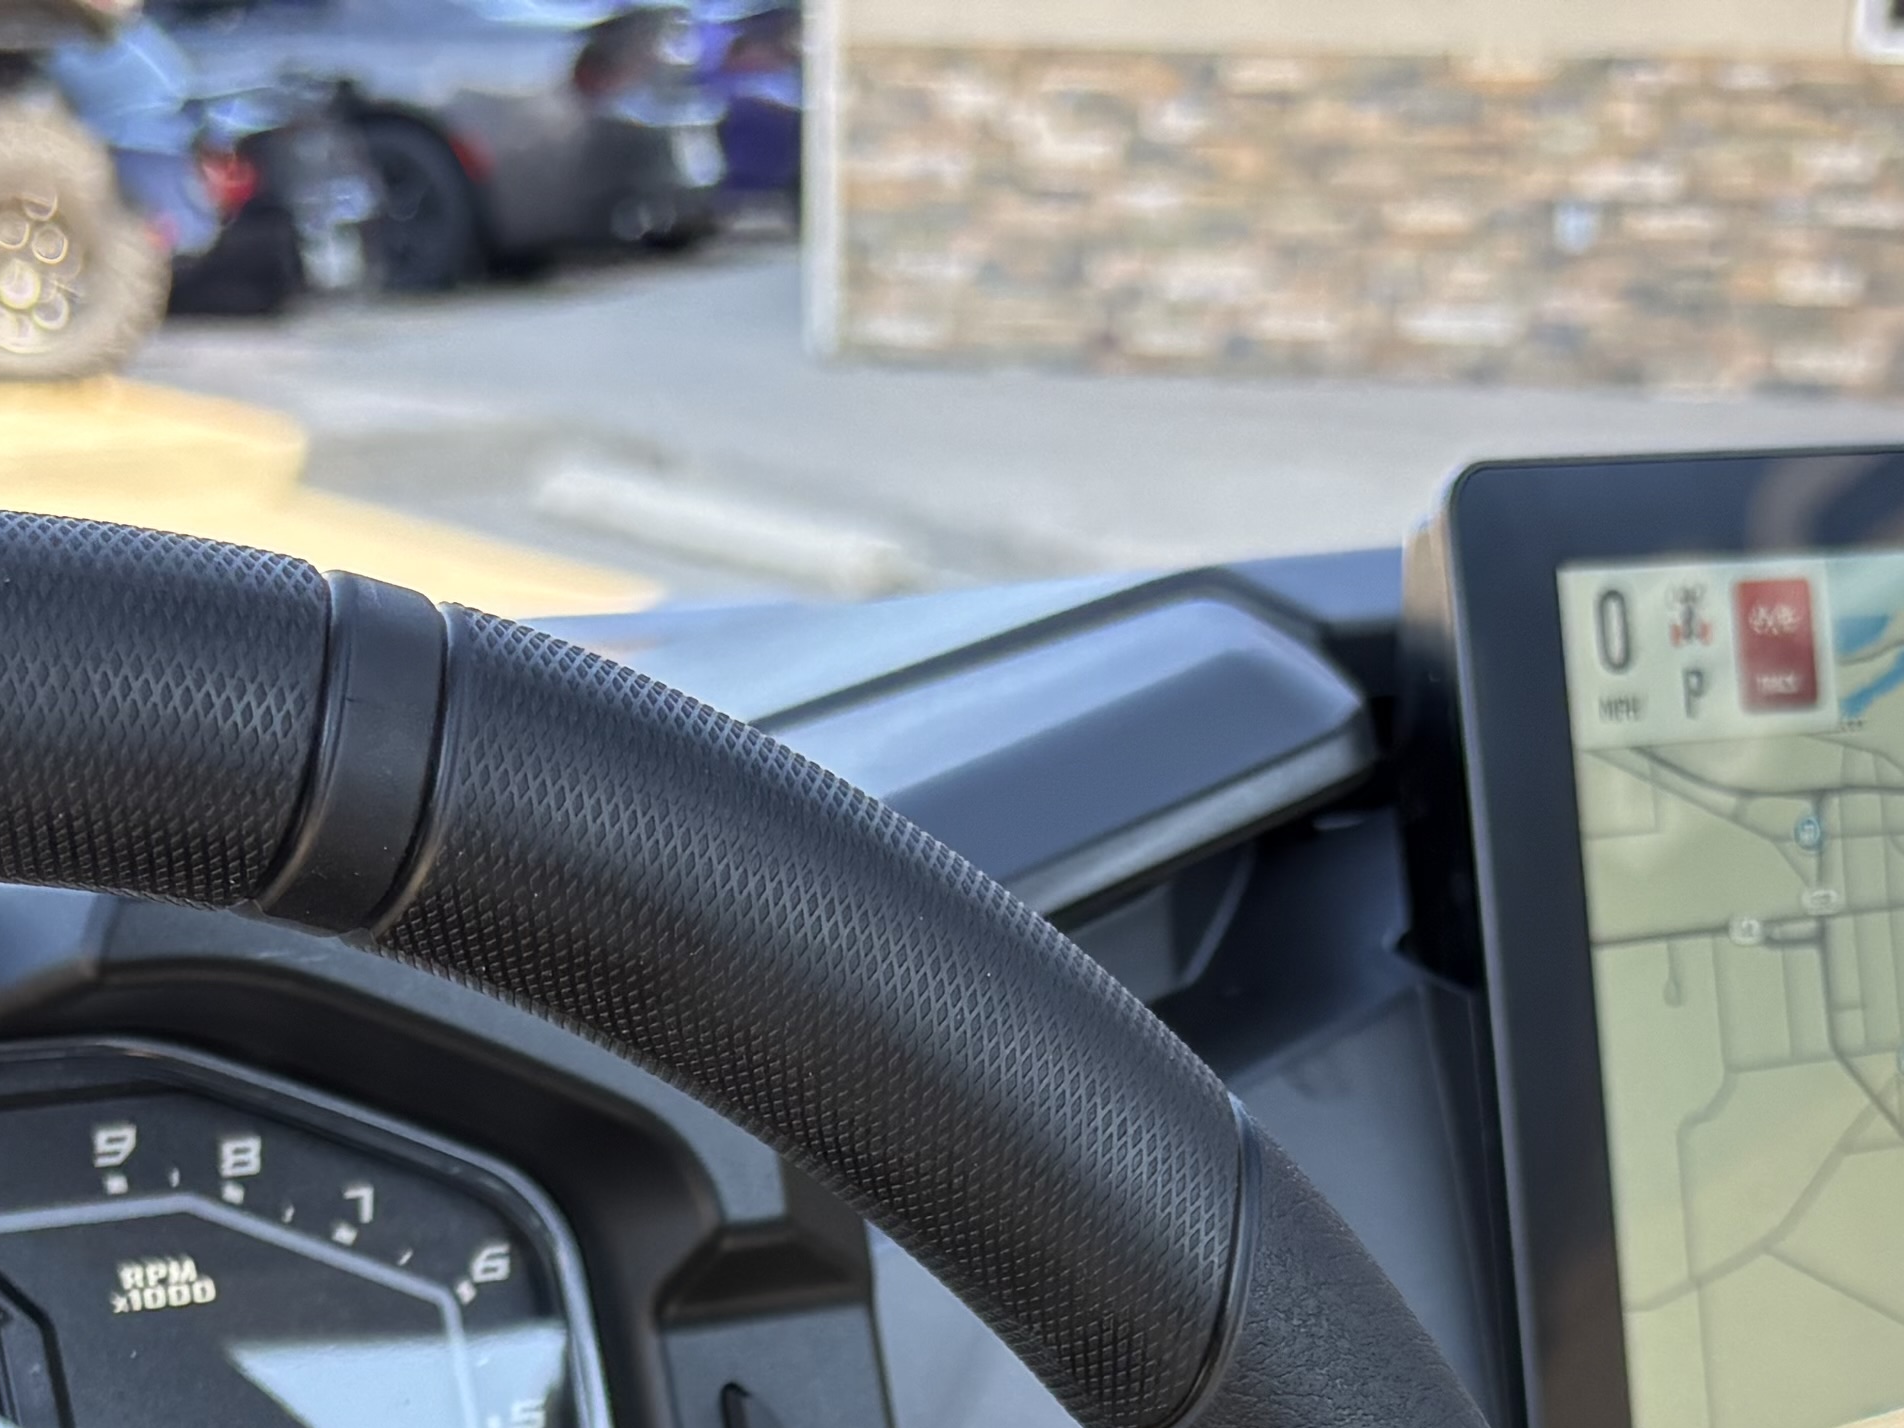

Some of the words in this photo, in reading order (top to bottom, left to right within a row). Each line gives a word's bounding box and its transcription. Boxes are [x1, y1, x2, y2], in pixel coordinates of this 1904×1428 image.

[93, 1124, 137, 1168] 9
[219, 1134, 261, 1178] 8
[343, 1183, 374, 1224] 7
[119, 1255, 197, 1291] RPM
[470, 1243, 511, 1283] 6
